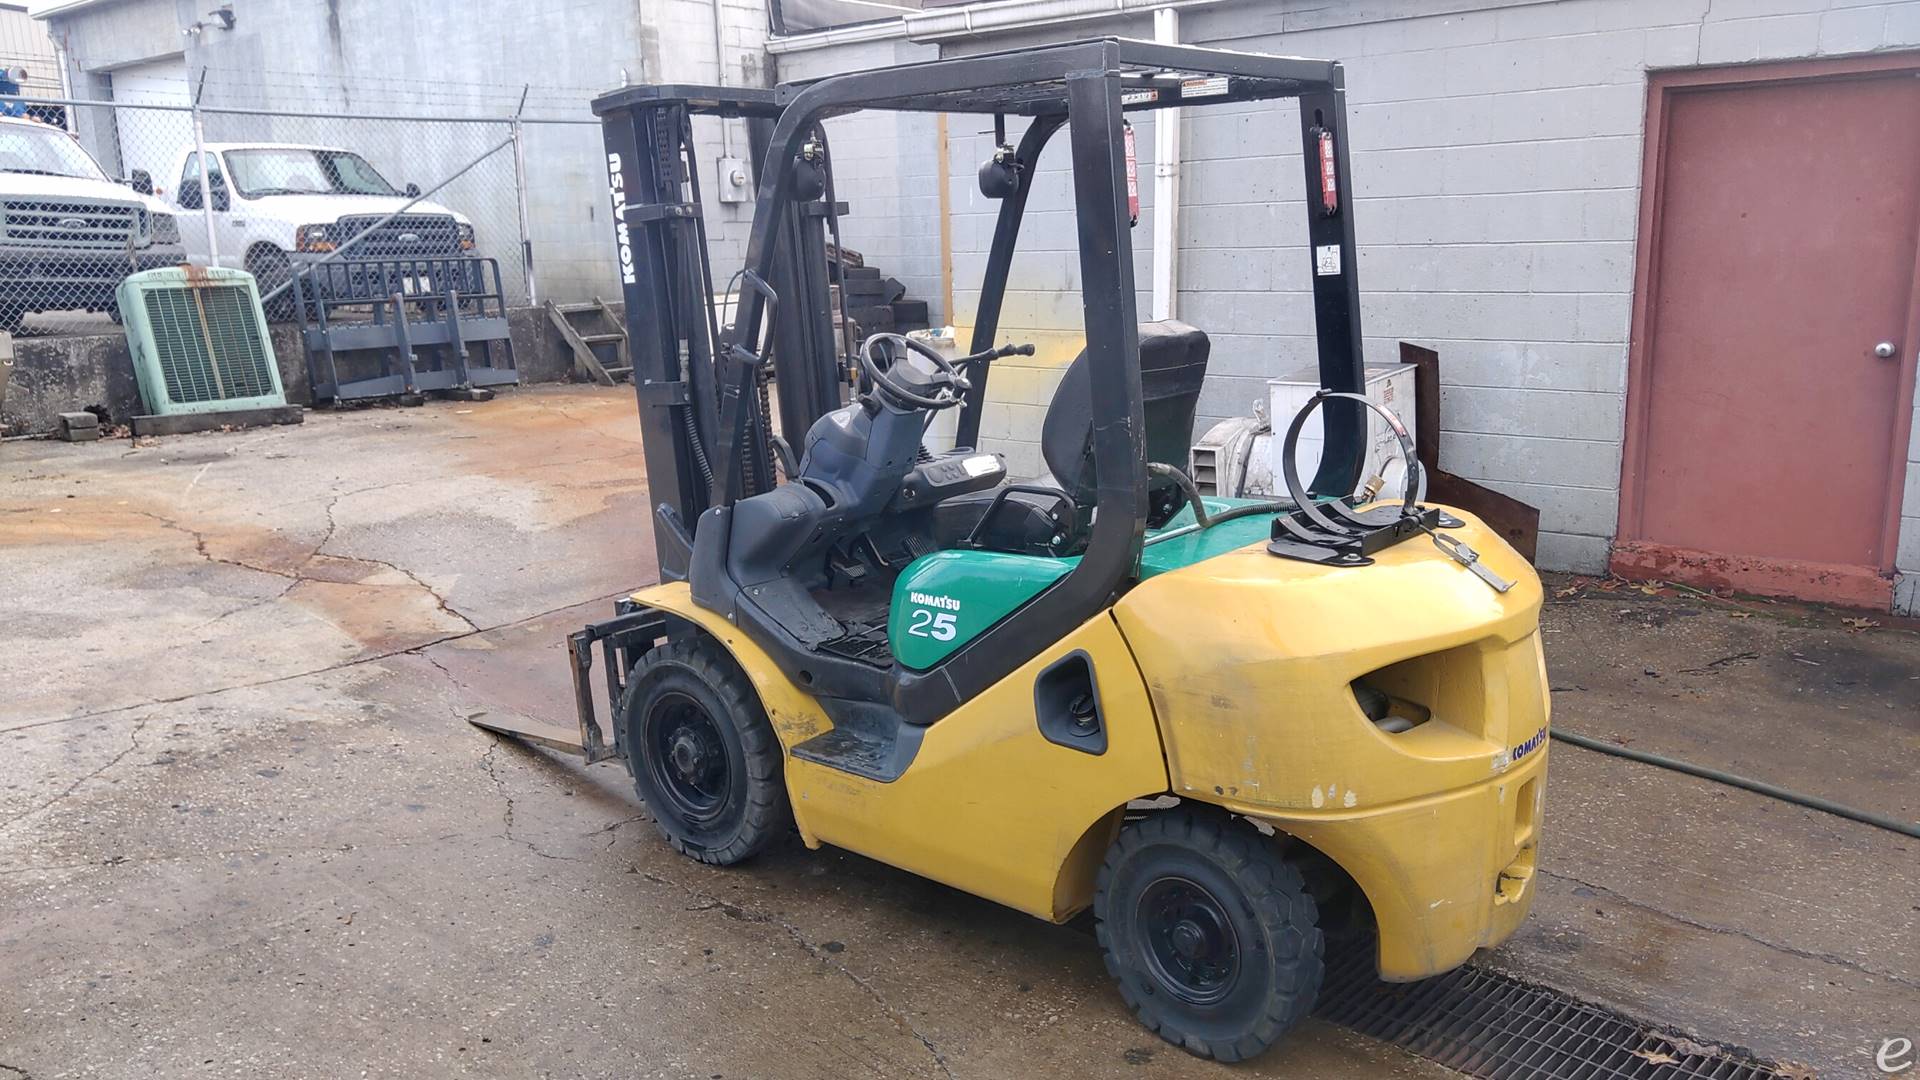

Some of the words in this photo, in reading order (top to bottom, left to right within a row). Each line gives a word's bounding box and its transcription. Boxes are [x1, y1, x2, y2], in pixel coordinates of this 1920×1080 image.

[608, 152, 636, 284] KOMATSU
[910, 591, 961, 611] KOMATSU
[908, 609, 957, 641] 25
